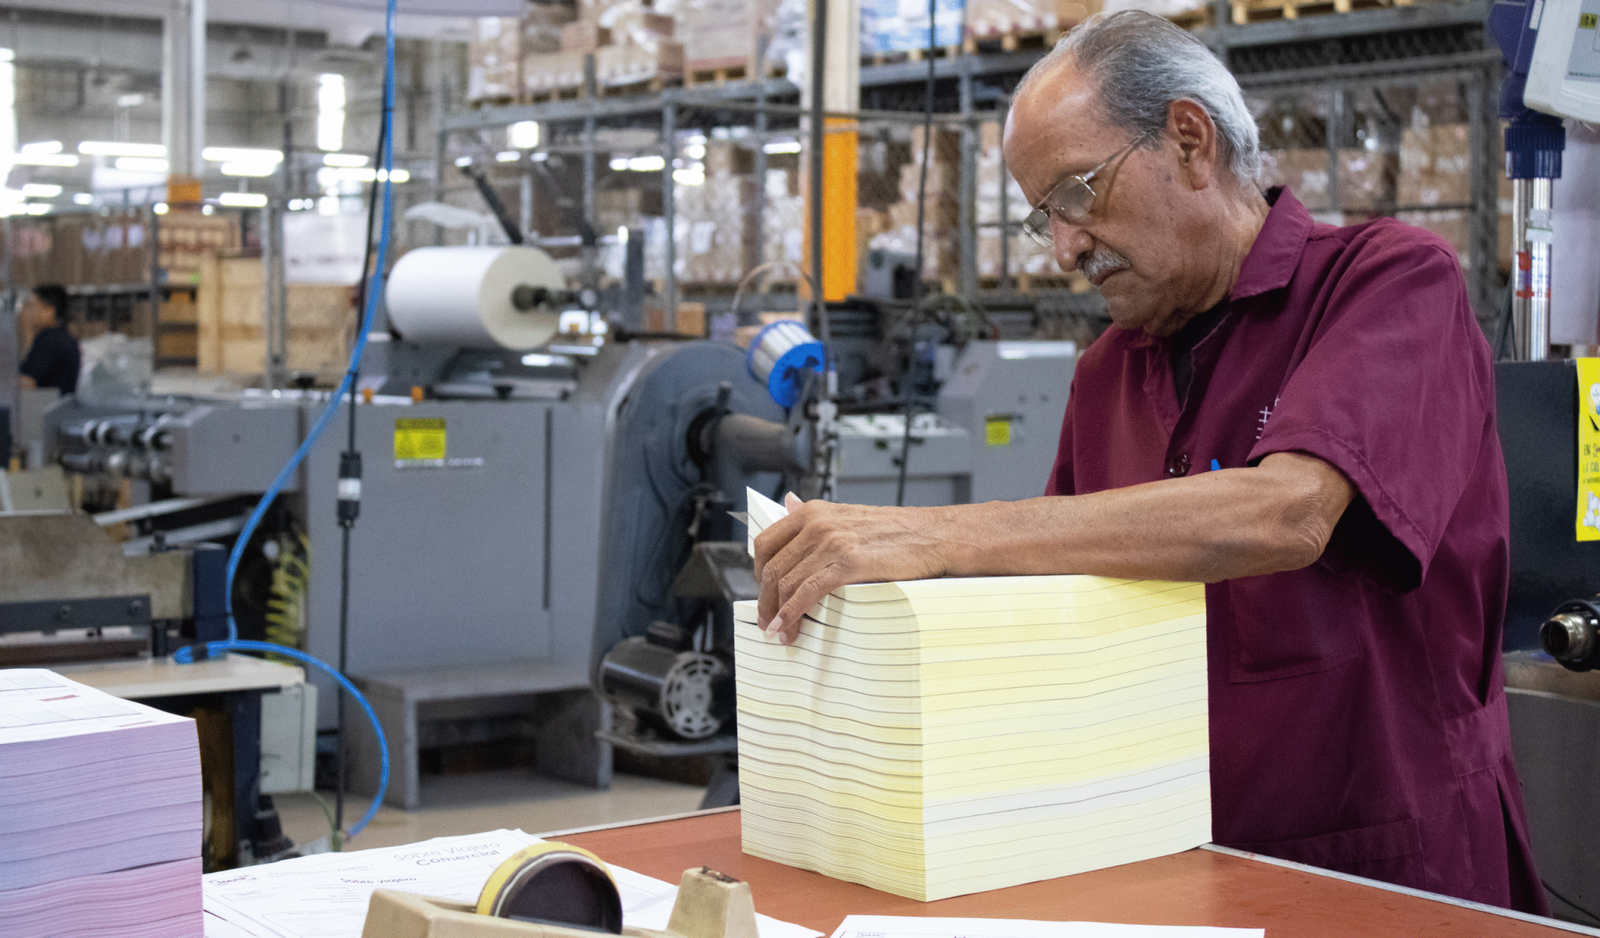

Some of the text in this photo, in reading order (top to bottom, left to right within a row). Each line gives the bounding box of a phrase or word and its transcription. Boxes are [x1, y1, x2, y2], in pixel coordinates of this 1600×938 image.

[393, 842, 500, 862] Sobre Viajero
[416, 849, 500, 866] Comercial
